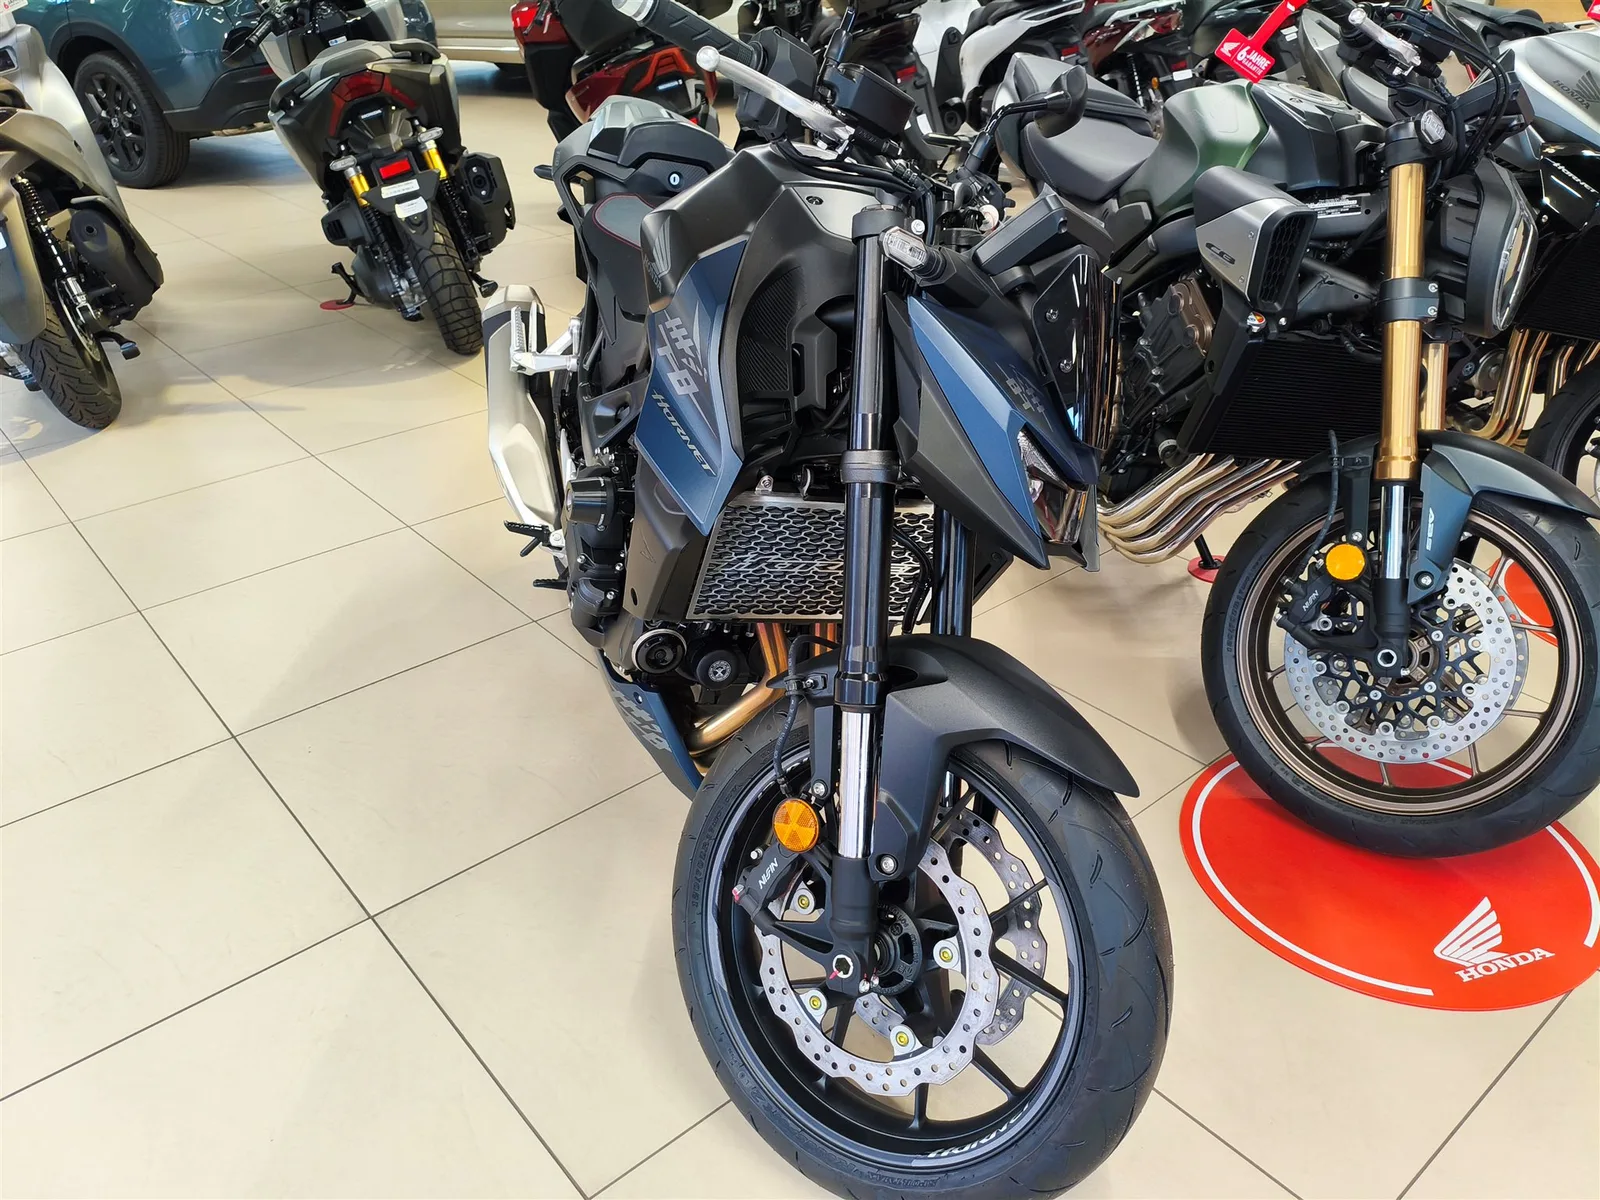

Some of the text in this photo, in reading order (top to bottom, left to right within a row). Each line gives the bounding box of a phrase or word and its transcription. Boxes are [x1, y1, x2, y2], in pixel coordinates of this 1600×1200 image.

[1236, 45, 1272, 71] 6 JAHRE
[1552, 79, 1592, 110] HONDA
[1455, 947, 1555, 983] HONDA
